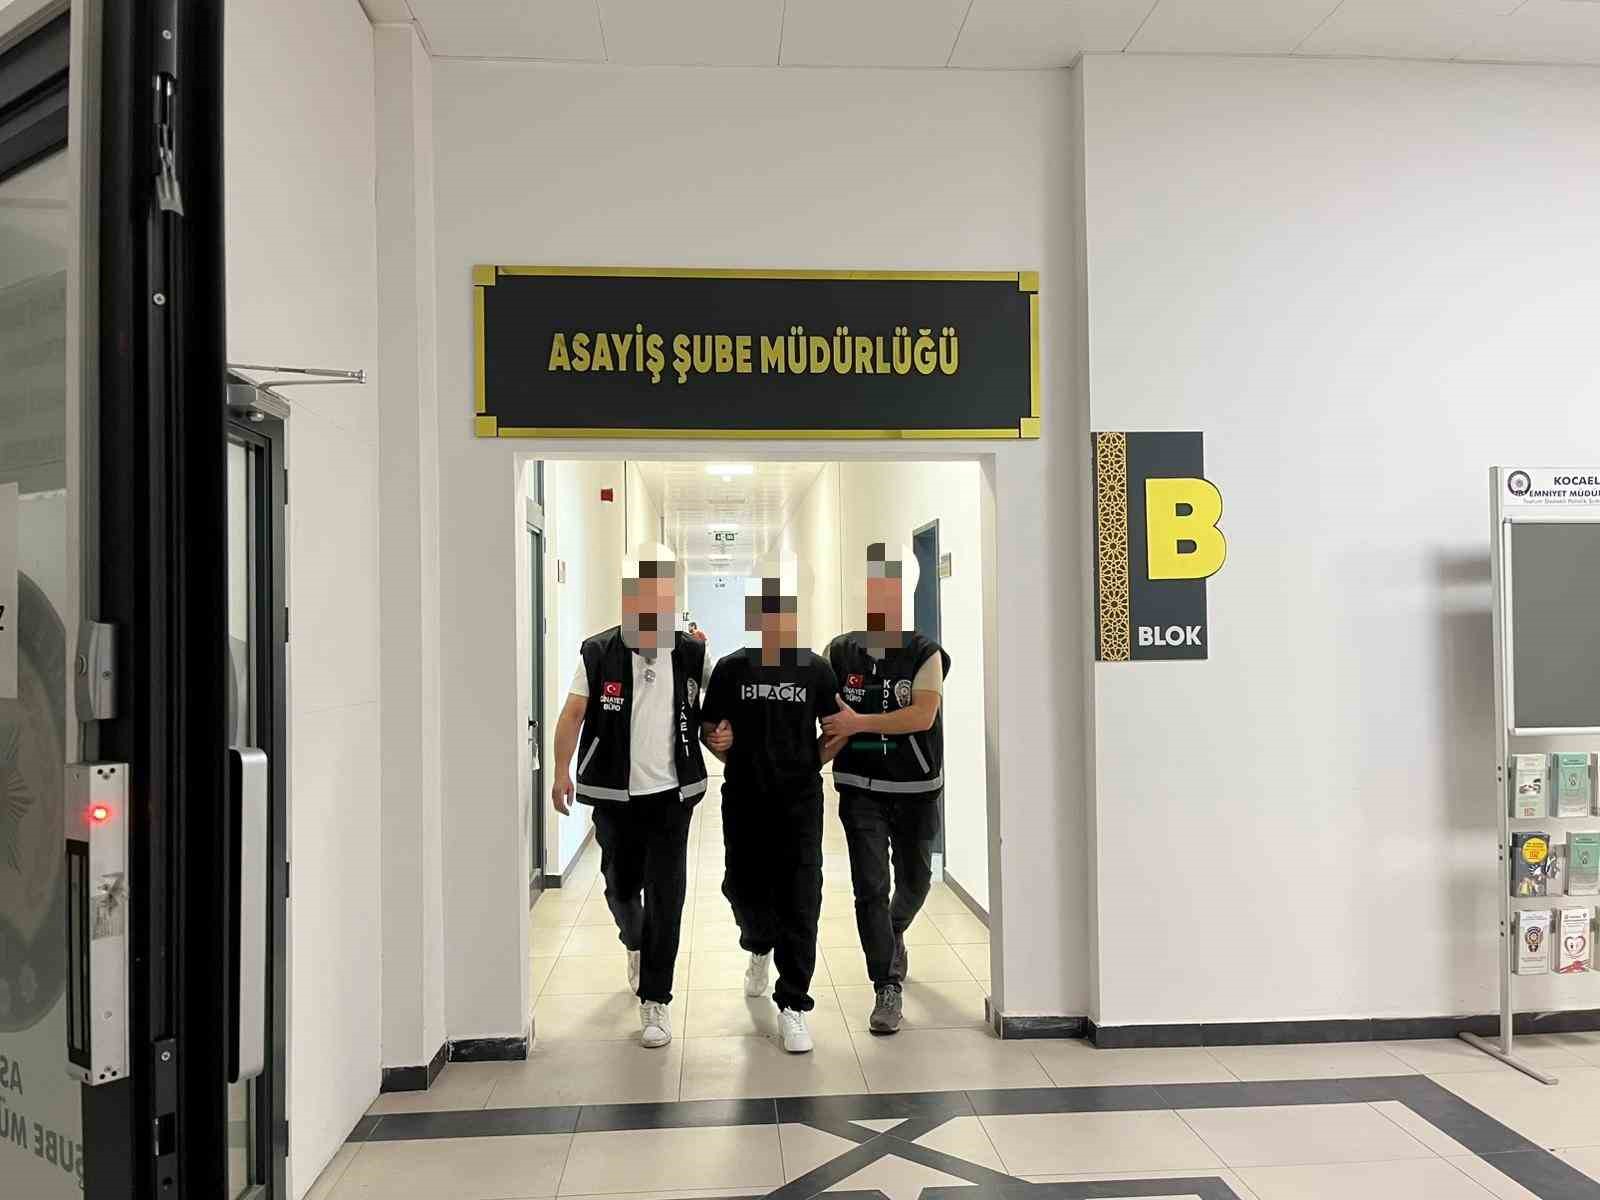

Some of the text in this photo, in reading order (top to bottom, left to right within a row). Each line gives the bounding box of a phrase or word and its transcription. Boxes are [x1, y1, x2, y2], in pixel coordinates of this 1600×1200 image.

[548, 323, 960, 384] ASAYİŞ ŞUBE MÜDÜRLÜĞÜ
[1145, 477, 1226, 580] B
[1138, 625, 1202, 647] BLOK
[741, 682, 807, 704] BLACK
